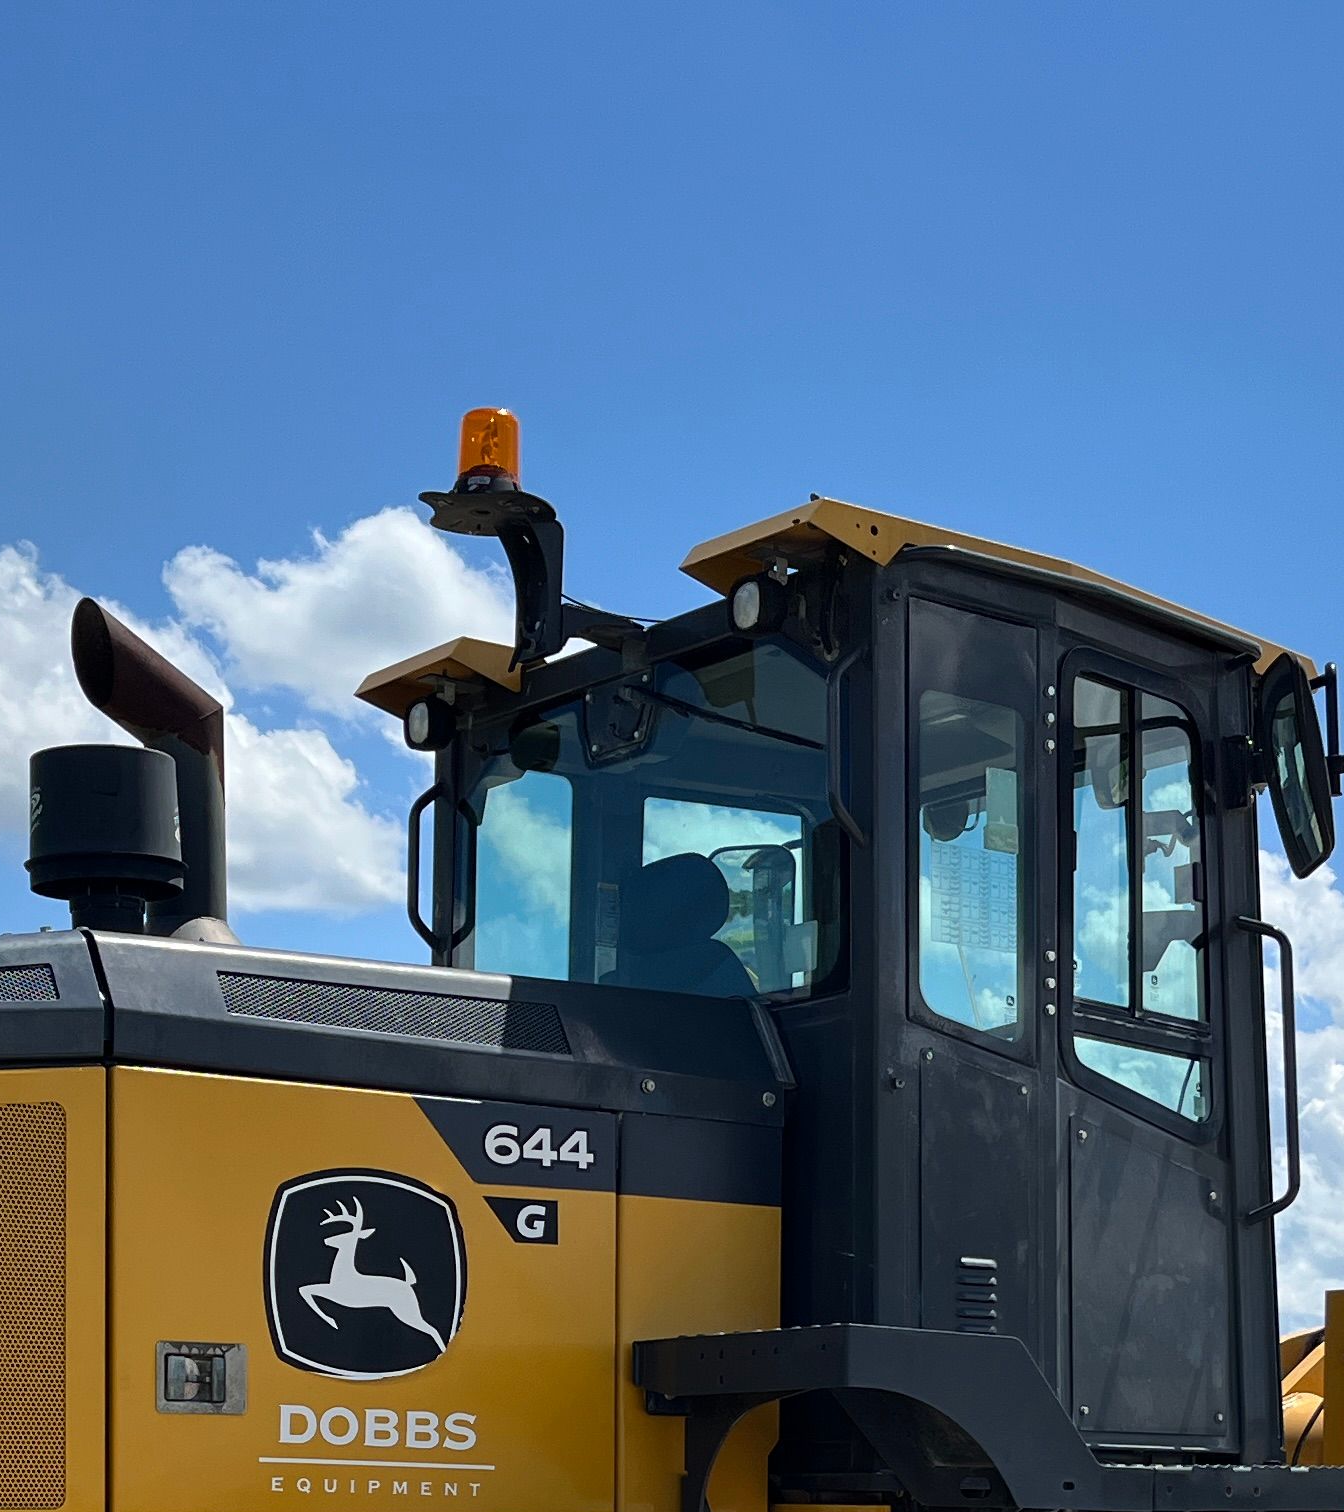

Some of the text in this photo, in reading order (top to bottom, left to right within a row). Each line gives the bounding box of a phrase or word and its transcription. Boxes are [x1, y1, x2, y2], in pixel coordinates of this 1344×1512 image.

[484, 1124, 594, 1170] 644
[517, 1204, 546, 1239] G
[278, 1404, 478, 1451] DOBBS
[270, 1475, 482, 1498] EQUIPMENT
